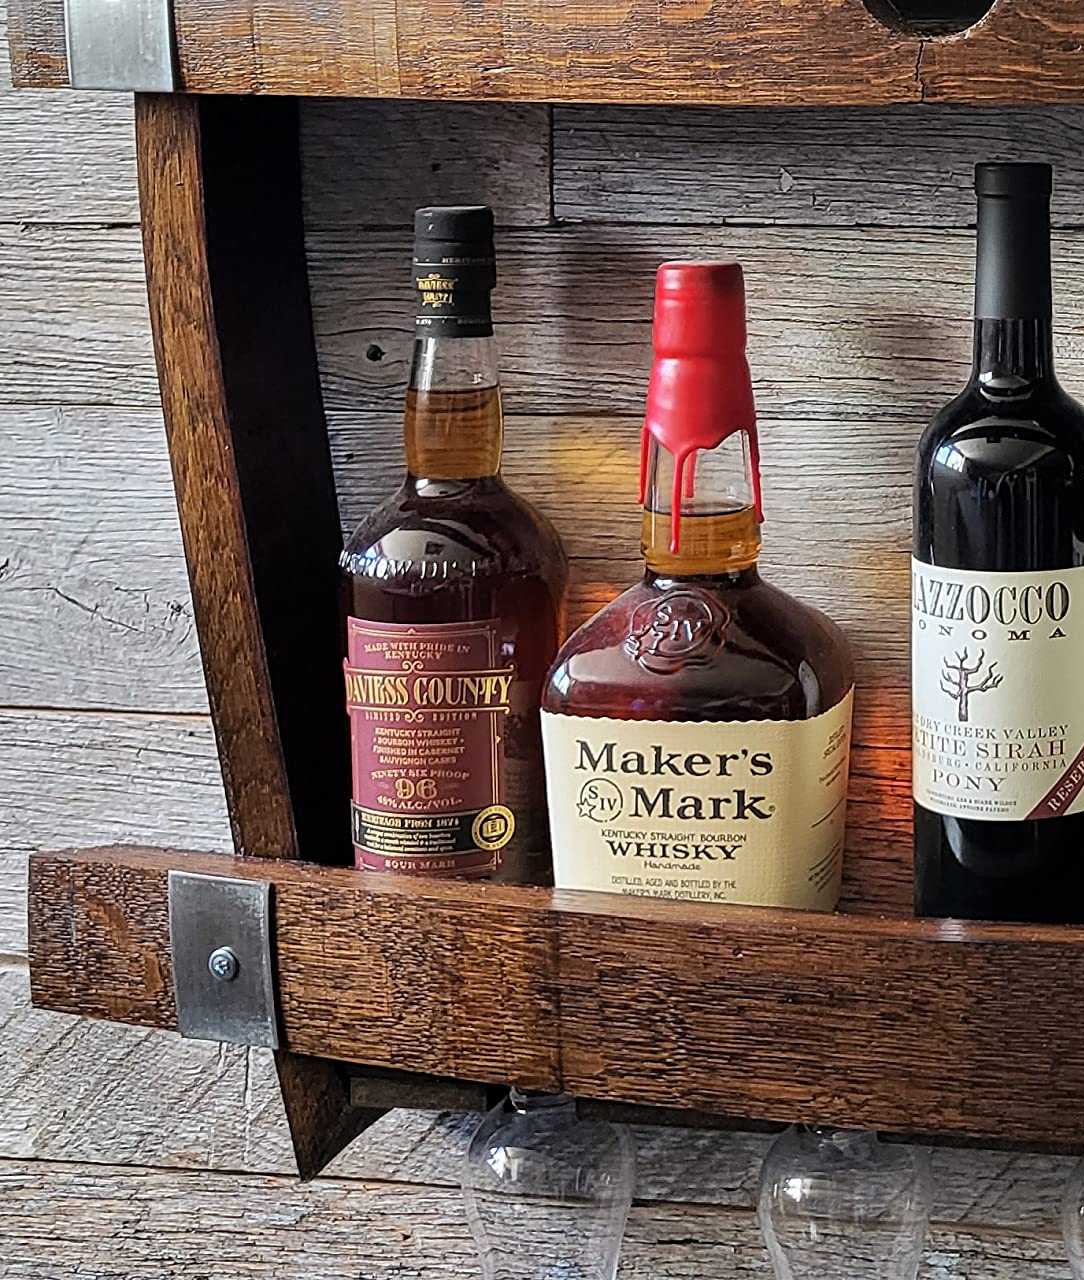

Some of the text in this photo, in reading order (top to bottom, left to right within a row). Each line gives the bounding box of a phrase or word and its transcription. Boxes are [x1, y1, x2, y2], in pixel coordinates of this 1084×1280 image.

[918, 618, 1067, 641] ONOMA
[363, 642, 471, 654] MADE WITH PRIDE IN
[385, 650, 443, 659] KENTUCKY
[345, 673, 409, 705] DAVIESS
[365, 711, 478, 722] LIMITED EDITION
[375, 727, 461, 737] KENTUCKY STRAIGHT
[944, 724, 997, 740] CREEK
[1003, 724, 1069, 740] VALLEY
[377, 737, 415, 747] BOURBON
[419, 746, 466, 756] CABERNET
[976, 738, 1067, 760] SIRAH
[379, 755, 428, 765] SAUVIGNON
[574, 739, 774, 776] Maker's
[975, 759, 1067, 772] CALIFORNIA
[370, 769, 407, 780] NINETY
[430, 770, 470, 780] PROOF
[932, 768, 1007, 792] PONY
[394, 778, 438, 799] 96
[600, 797, 618, 813] IV
[601, 828, 747, 843] KENTUCKY STRAIGHT BOURBON
[605, 839, 743, 860] WHISKY
[384, 859, 417, 870] SOUR
[643, 860, 701, 871] Handmade
[645, 877, 663, 887] AGED
[665, 879, 679, 888] AND
[680, 879, 711, 889] BOTTLED
[712, 880, 722, 889] BY
[723, 880, 737, 889] THE
